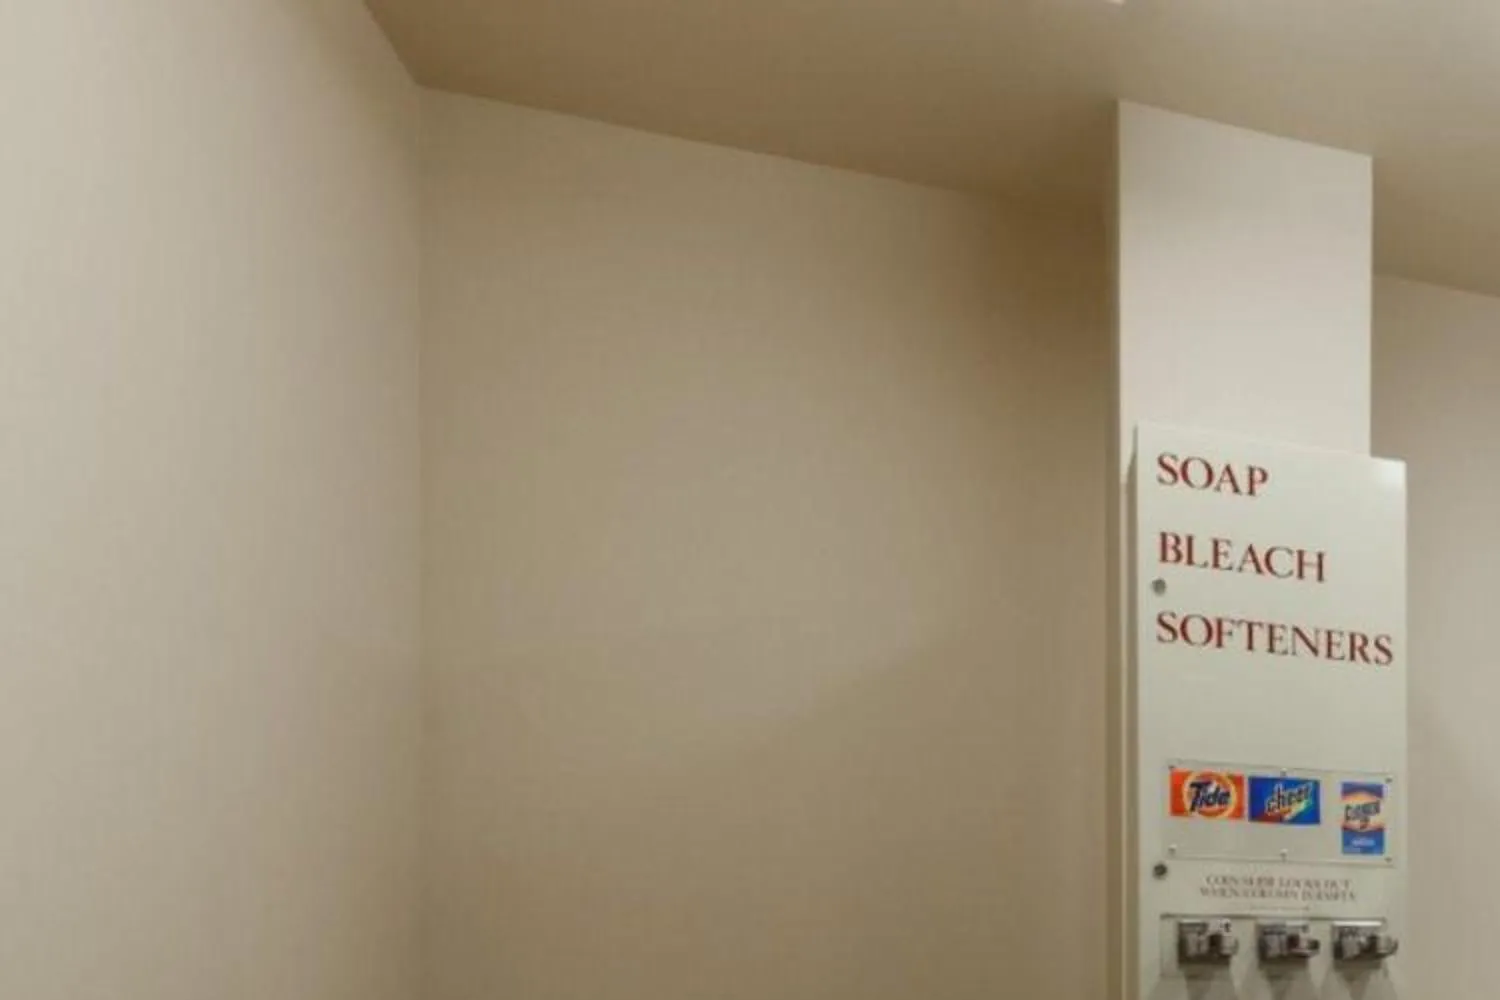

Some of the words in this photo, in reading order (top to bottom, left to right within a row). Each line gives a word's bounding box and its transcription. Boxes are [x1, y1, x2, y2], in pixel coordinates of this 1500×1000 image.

[1156, 452, 1268, 496] SOAP
[1158, 531, 1325, 582] BLEACH
[1156, 611, 1394, 666] SOFTENERS
[1189, 780, 1231, 813] Tide
